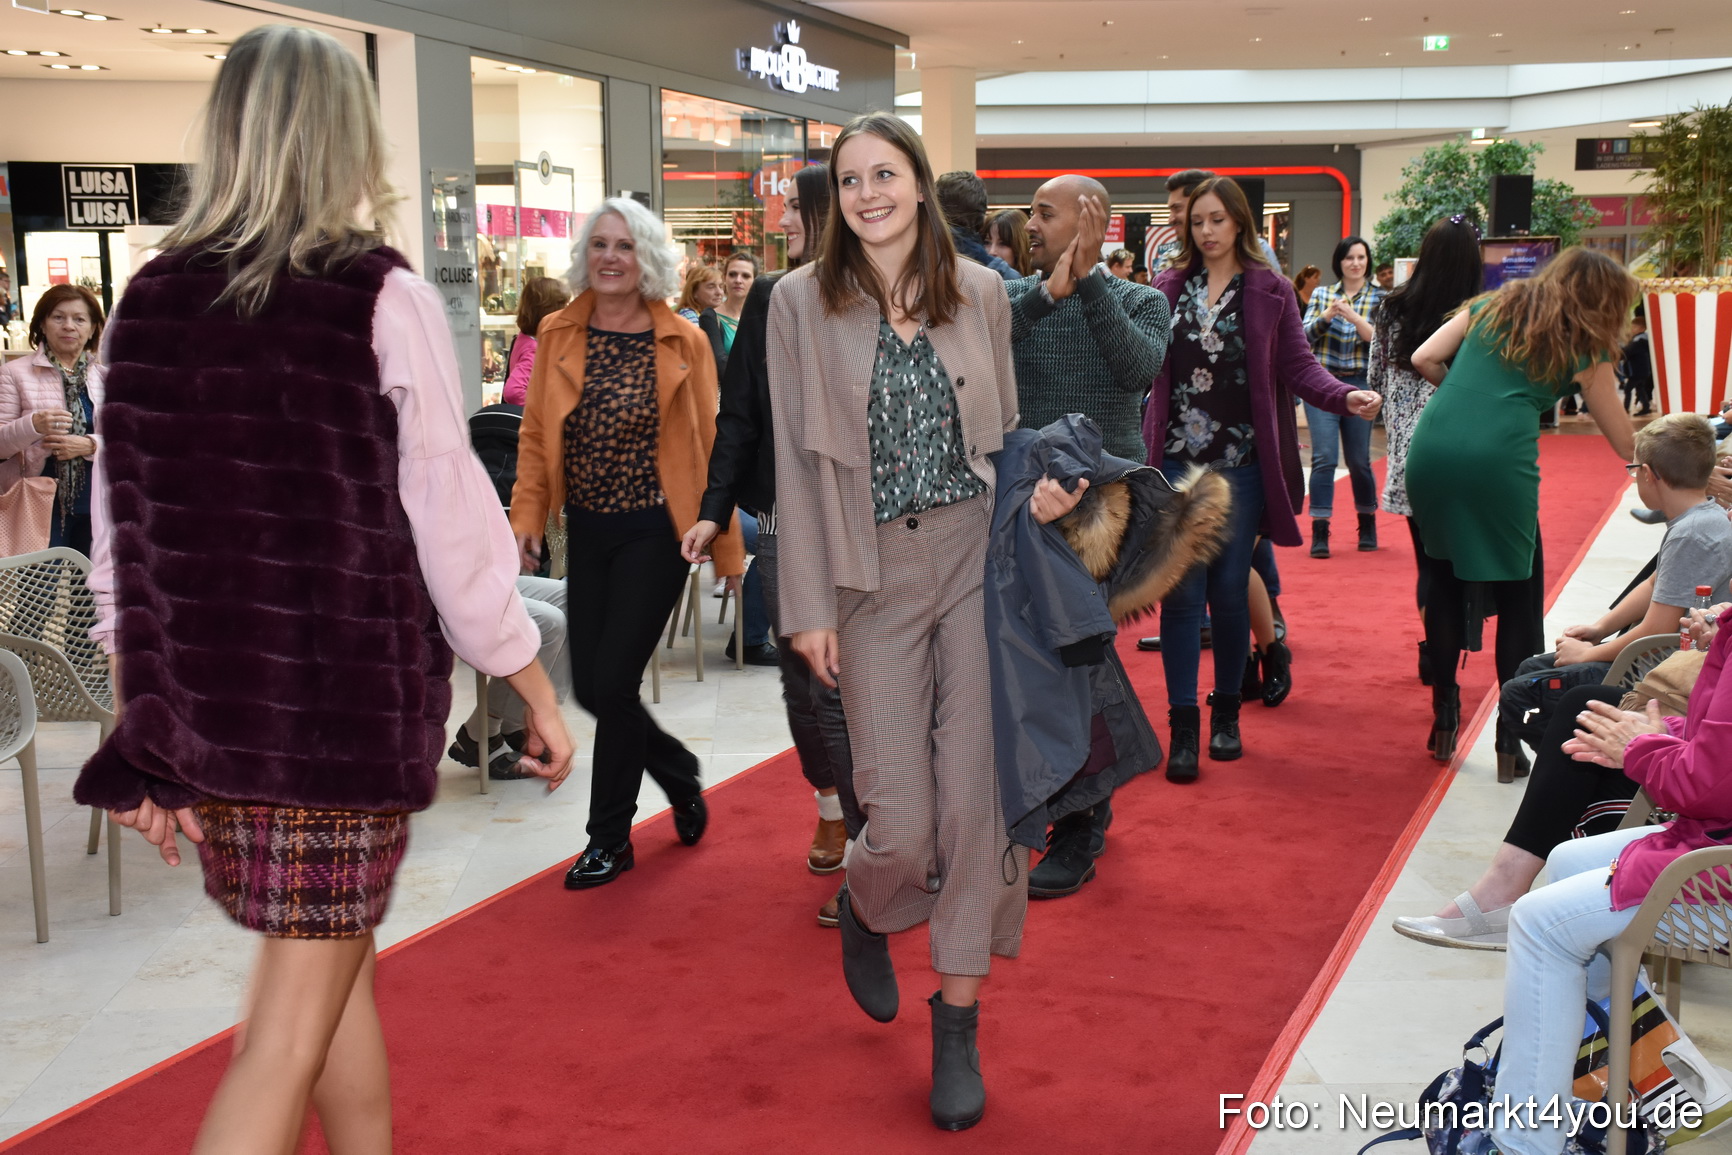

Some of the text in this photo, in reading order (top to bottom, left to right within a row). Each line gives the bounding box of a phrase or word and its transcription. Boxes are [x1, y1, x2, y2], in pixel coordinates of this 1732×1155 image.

[68, 171, 130, 194] LUISA
[71, 202, 132, 224] LUISA
[440, 267, 472, 283] CLUSE
